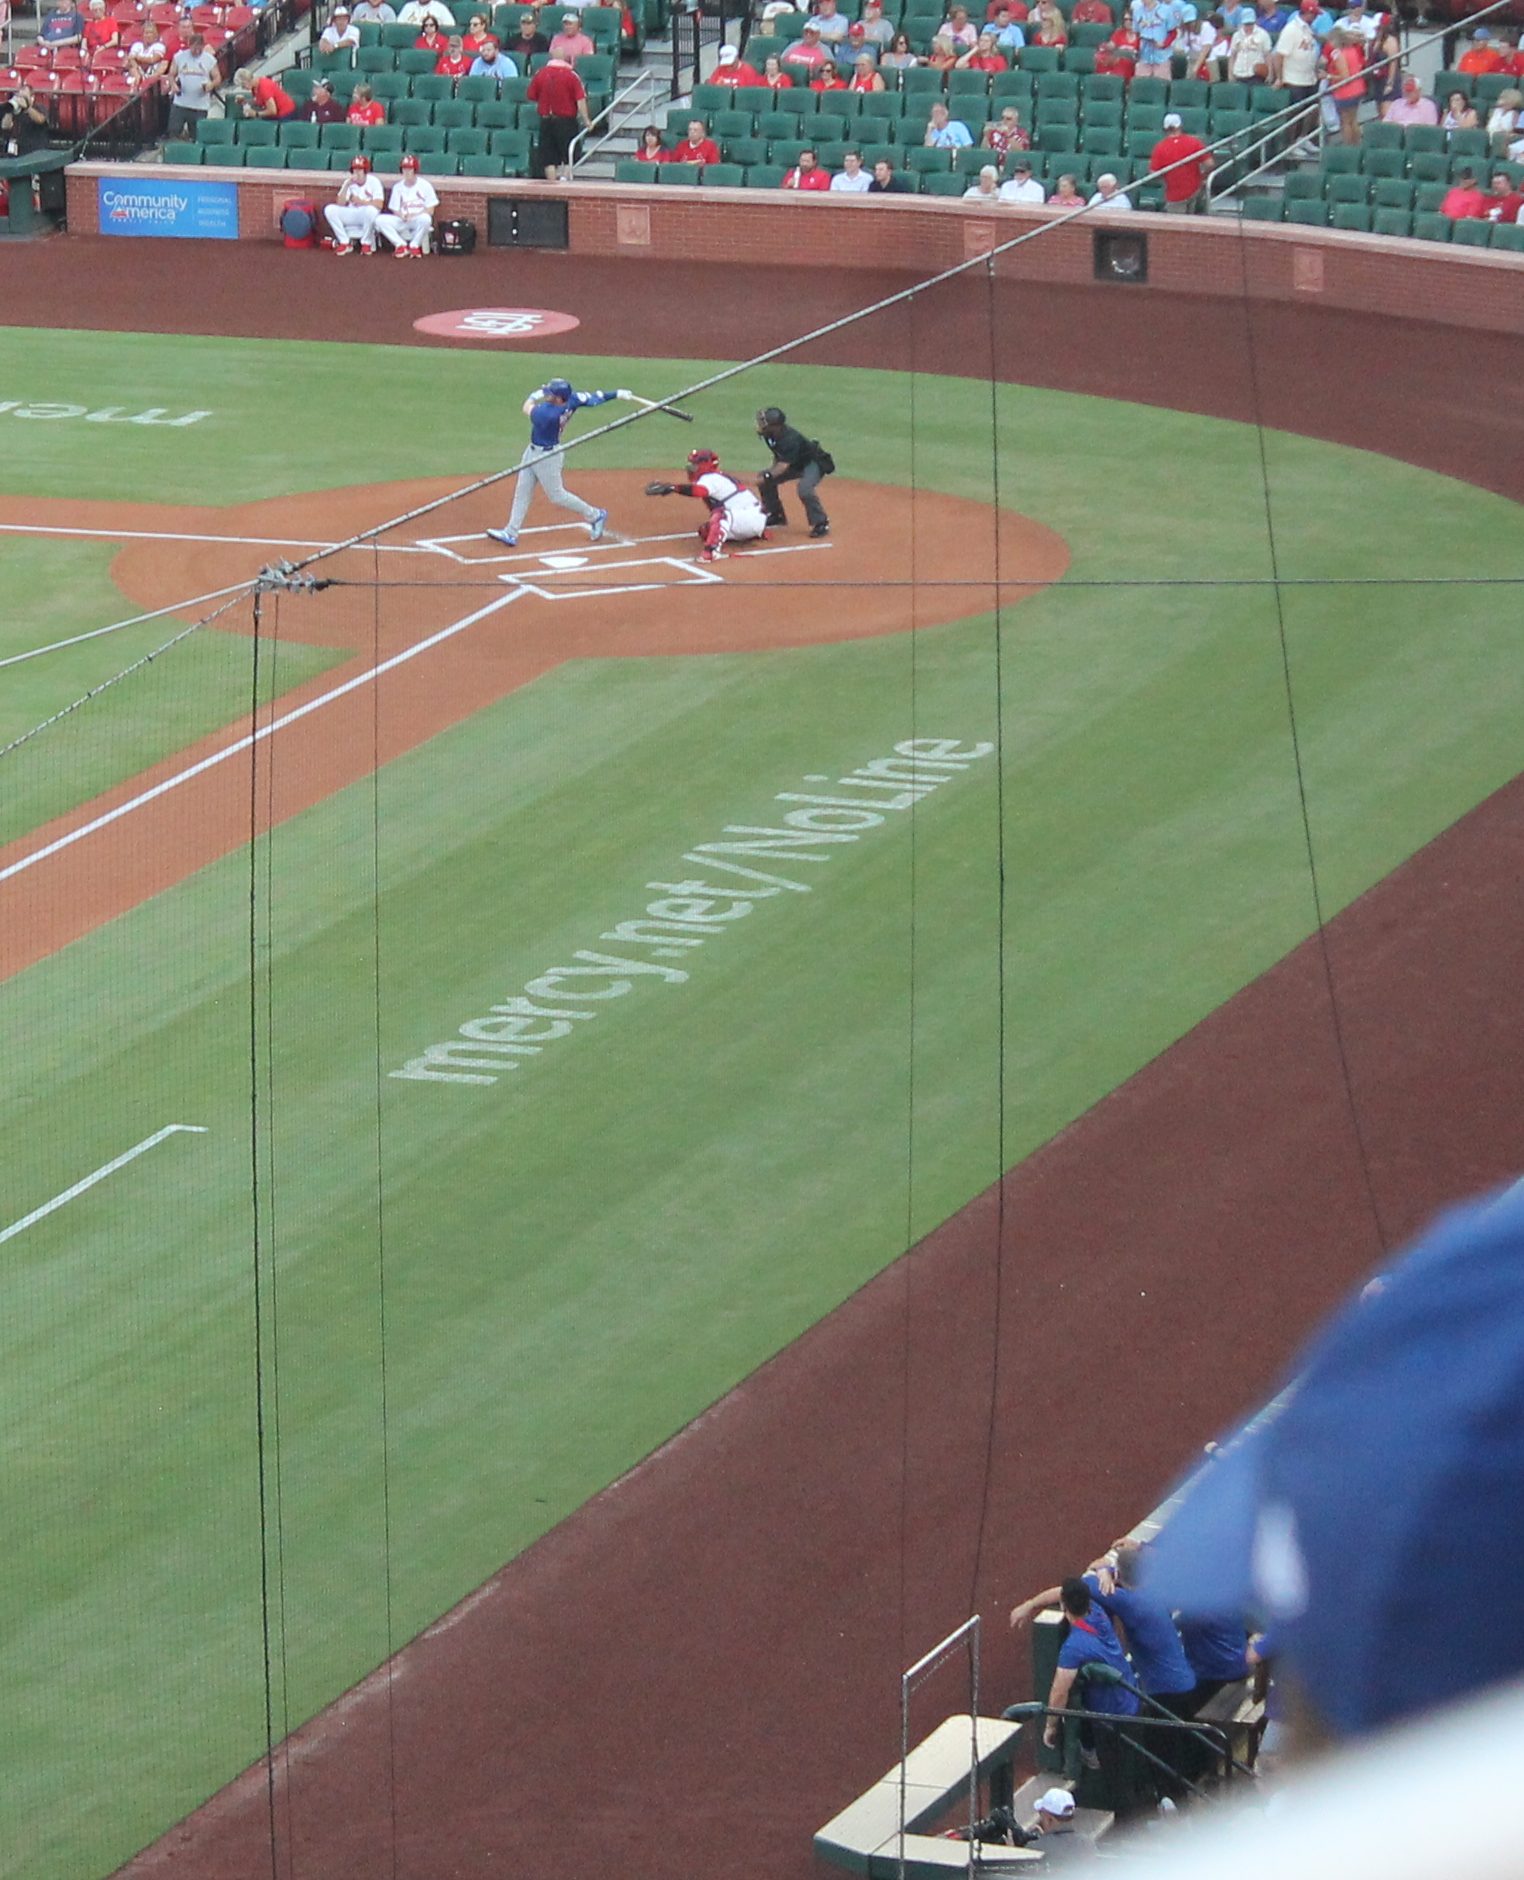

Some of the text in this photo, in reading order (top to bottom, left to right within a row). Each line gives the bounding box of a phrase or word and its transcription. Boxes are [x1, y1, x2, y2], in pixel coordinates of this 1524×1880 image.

[103, 191, 188, 212] Community
[109, 203, 176, 220] America
[388, 737, 994, 1085] mercy.net/NoLine
